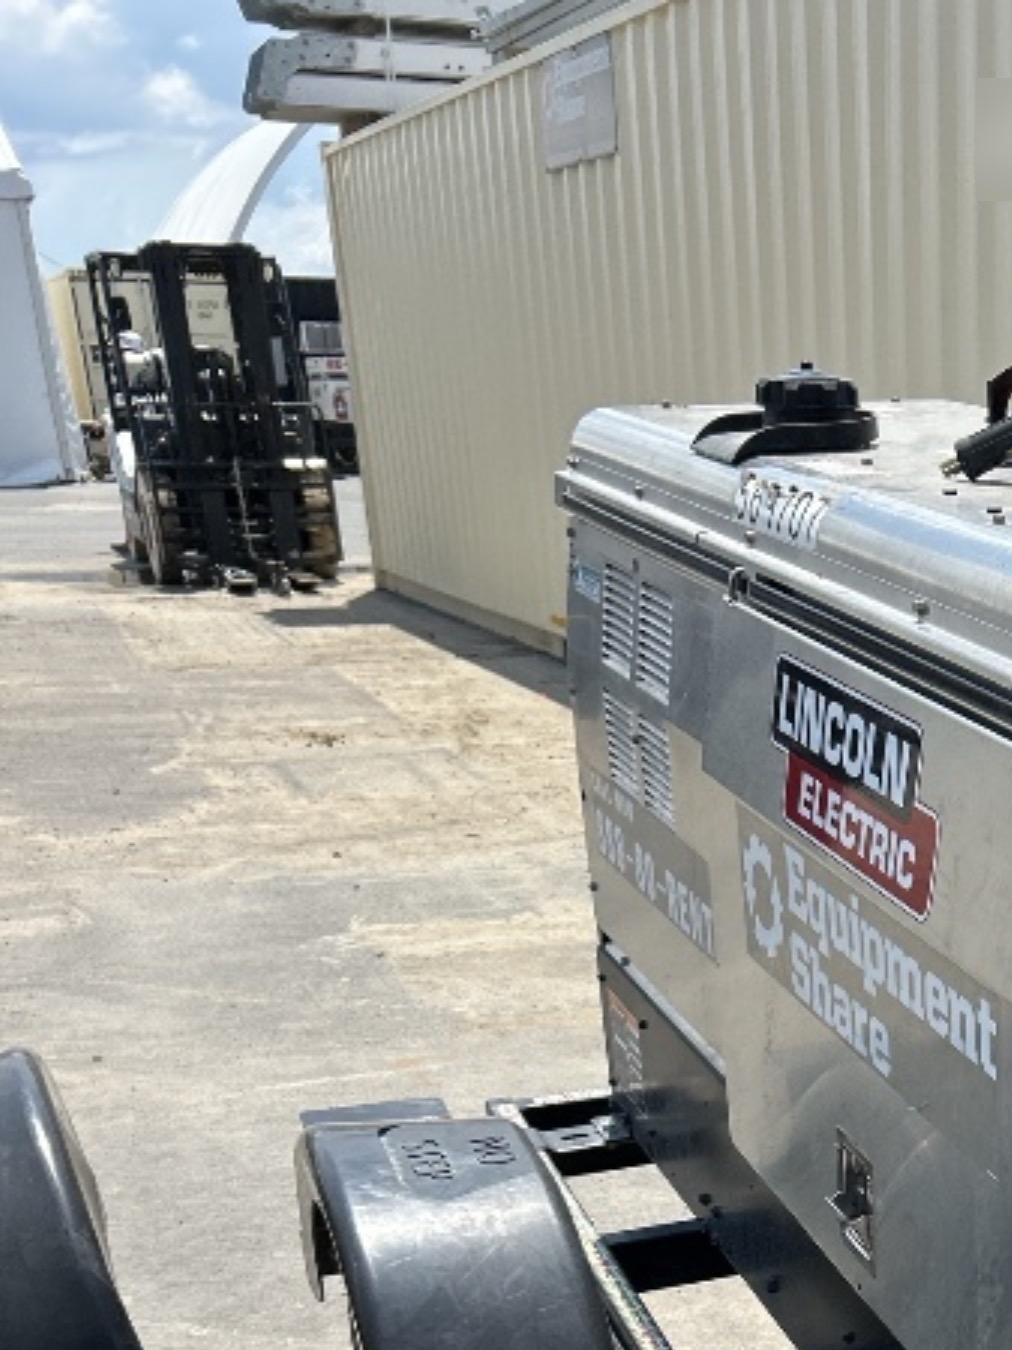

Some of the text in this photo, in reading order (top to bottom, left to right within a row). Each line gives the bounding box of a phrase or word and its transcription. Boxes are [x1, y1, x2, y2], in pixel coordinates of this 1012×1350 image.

[778, 672, 910, 808] LINCOLN
[798, 770, 917, 892] ELECTRIC
[784, 842, 998, 1082] Equipment
[790, 931, 893, 1079] Share
